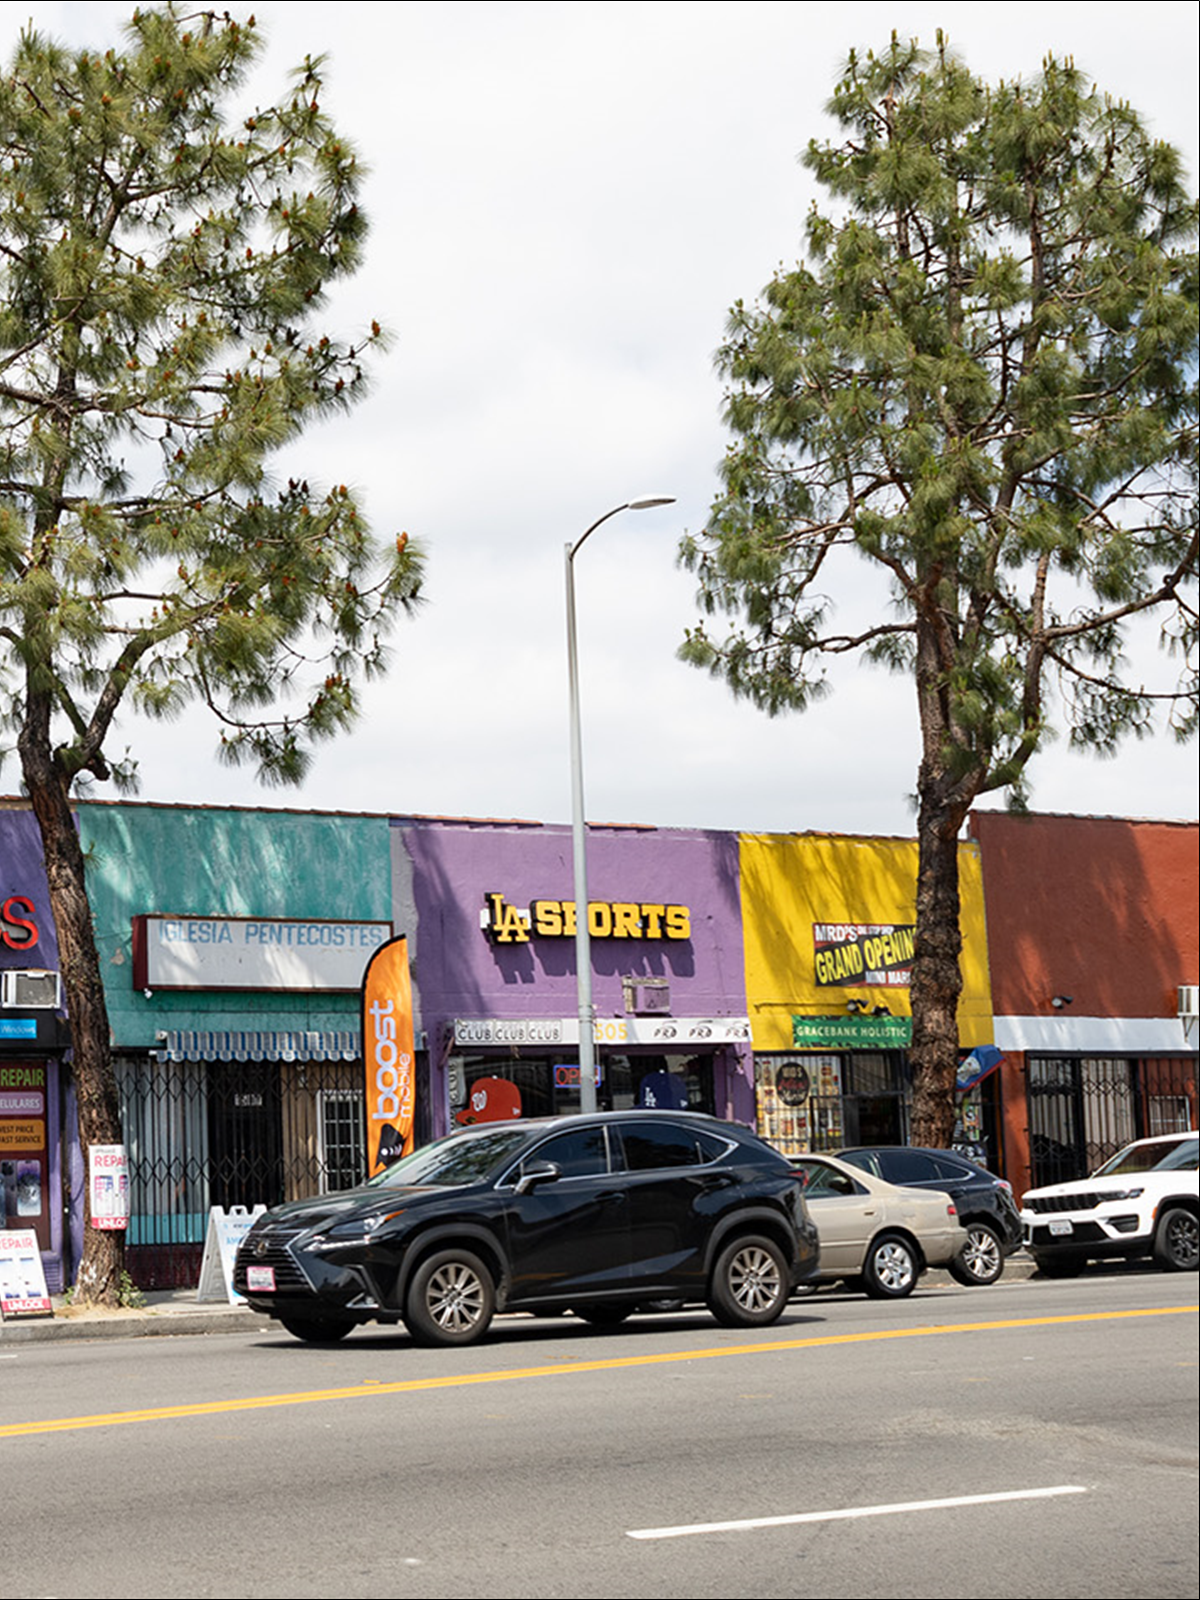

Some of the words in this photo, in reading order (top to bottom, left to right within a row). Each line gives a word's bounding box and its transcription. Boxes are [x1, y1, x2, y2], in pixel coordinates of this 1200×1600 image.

[490, 893, 530, 942] LA
[158, 920, 233, 944] IGLESIA
[245, 922, 383, 947] PENTECOSTES
[815, 943, 864, 984] GRAND
[863, 927, 917, 970] OPENIN
[865, 971, 887, 984] MINI
[1, 1025, 37, 1035] Windows
[458, 1028, 491, 1040] CLUB
[495, 1029, 525, 1040] CLUB
[529, 1029, 559, 1040] CLUB
[796, 1026, 857, 1037] GRACEBANK
[860, 1026, 907, 1037] HOLISTIC
[369, 1000, 399, 1120] boost
[0, 1068, 45, 1086] REPAIR
[399, 1053, 411, 1118] mobile
[15, 1125, 34, 1133] PRICE
[7, 1300, 46, 1311] UNLOCK
